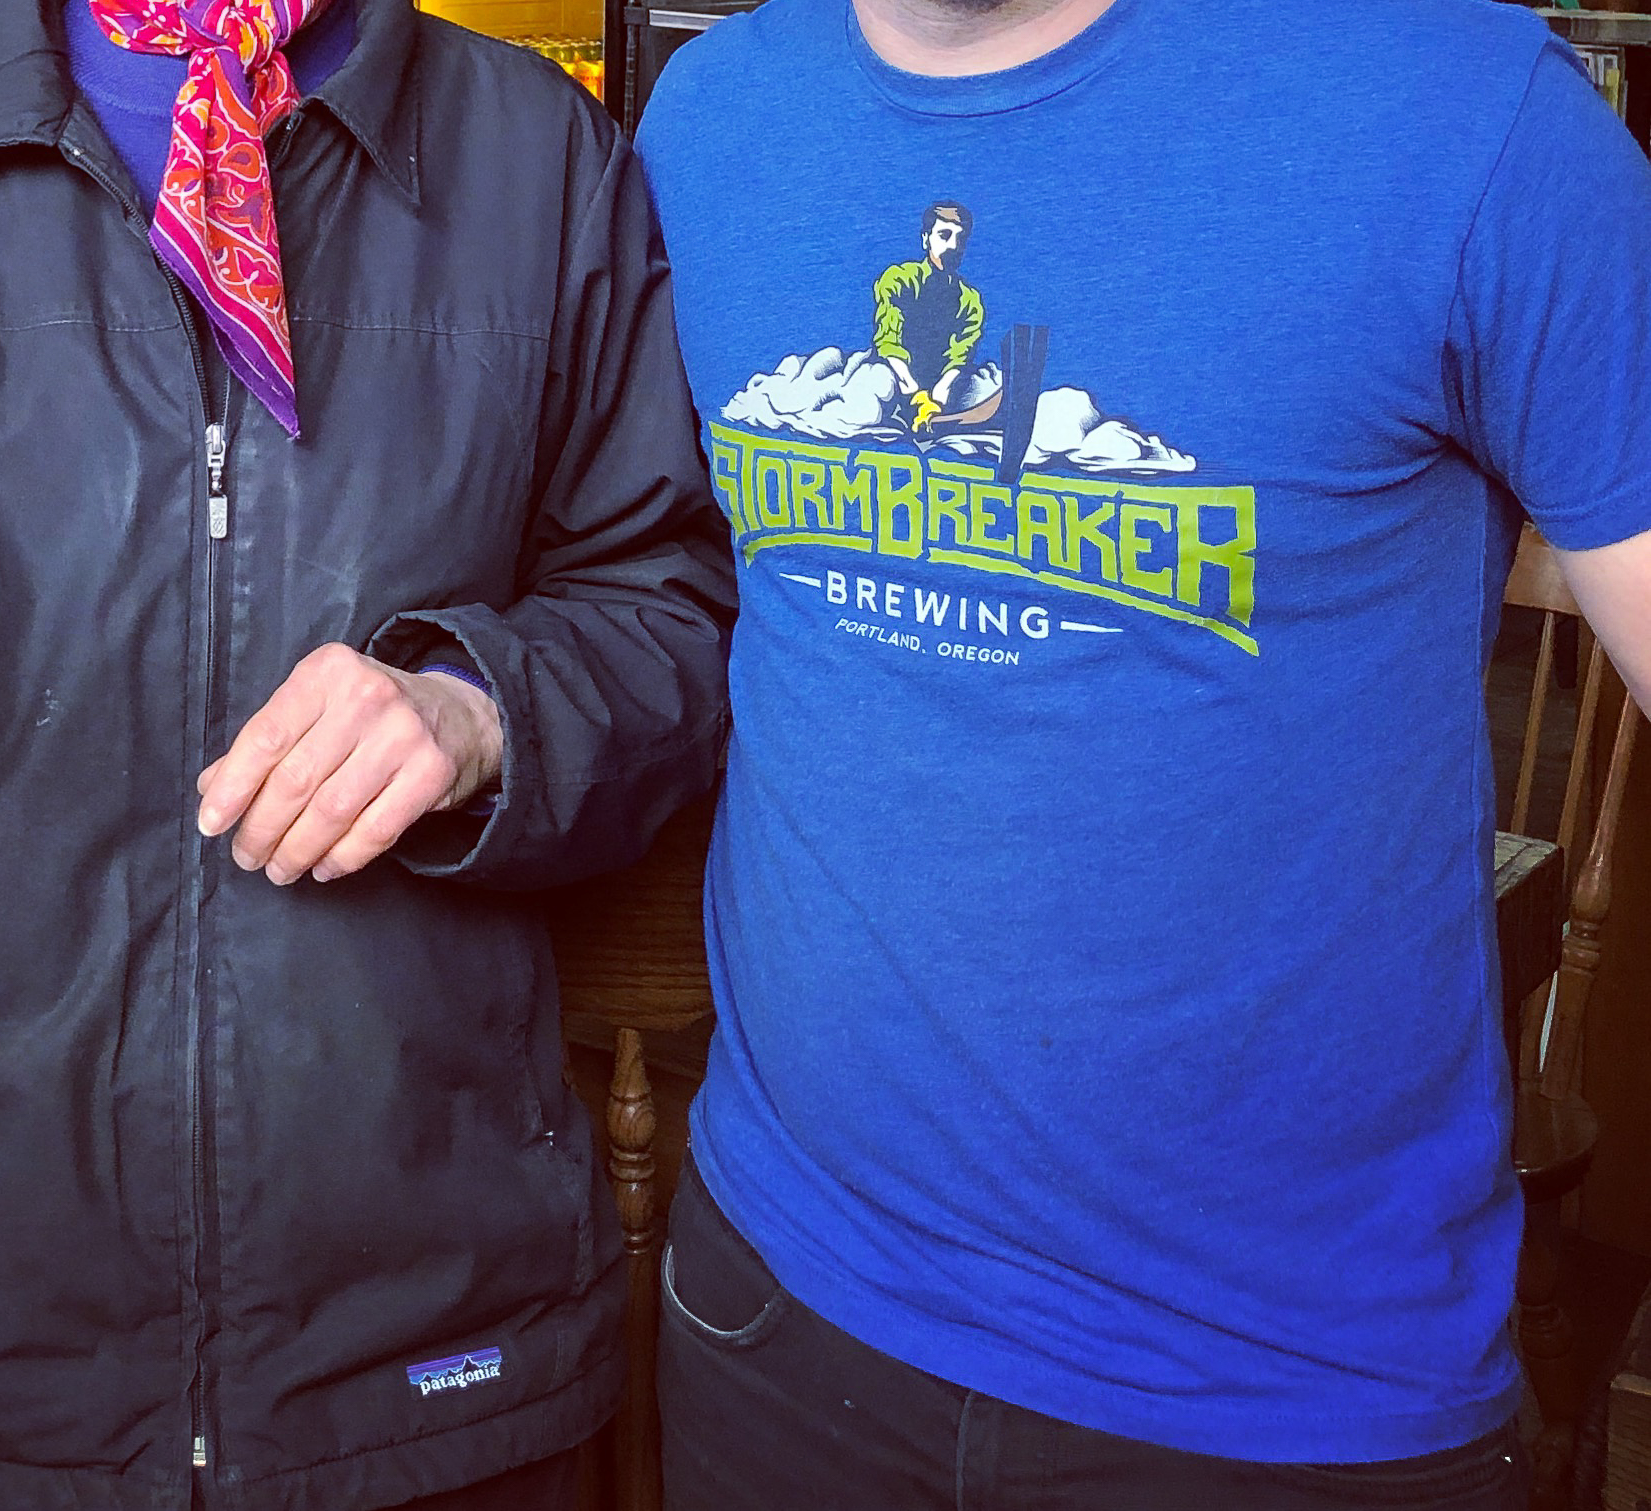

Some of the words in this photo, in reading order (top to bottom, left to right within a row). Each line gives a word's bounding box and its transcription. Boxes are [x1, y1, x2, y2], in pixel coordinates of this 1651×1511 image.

[708, 422, 1260, 657] STORMBREAKER
[825, 570, 1051, 639] BREWING
[937, 641, 1020, 666] OREGON
[419, 1364, 501, 1396] patagonia
